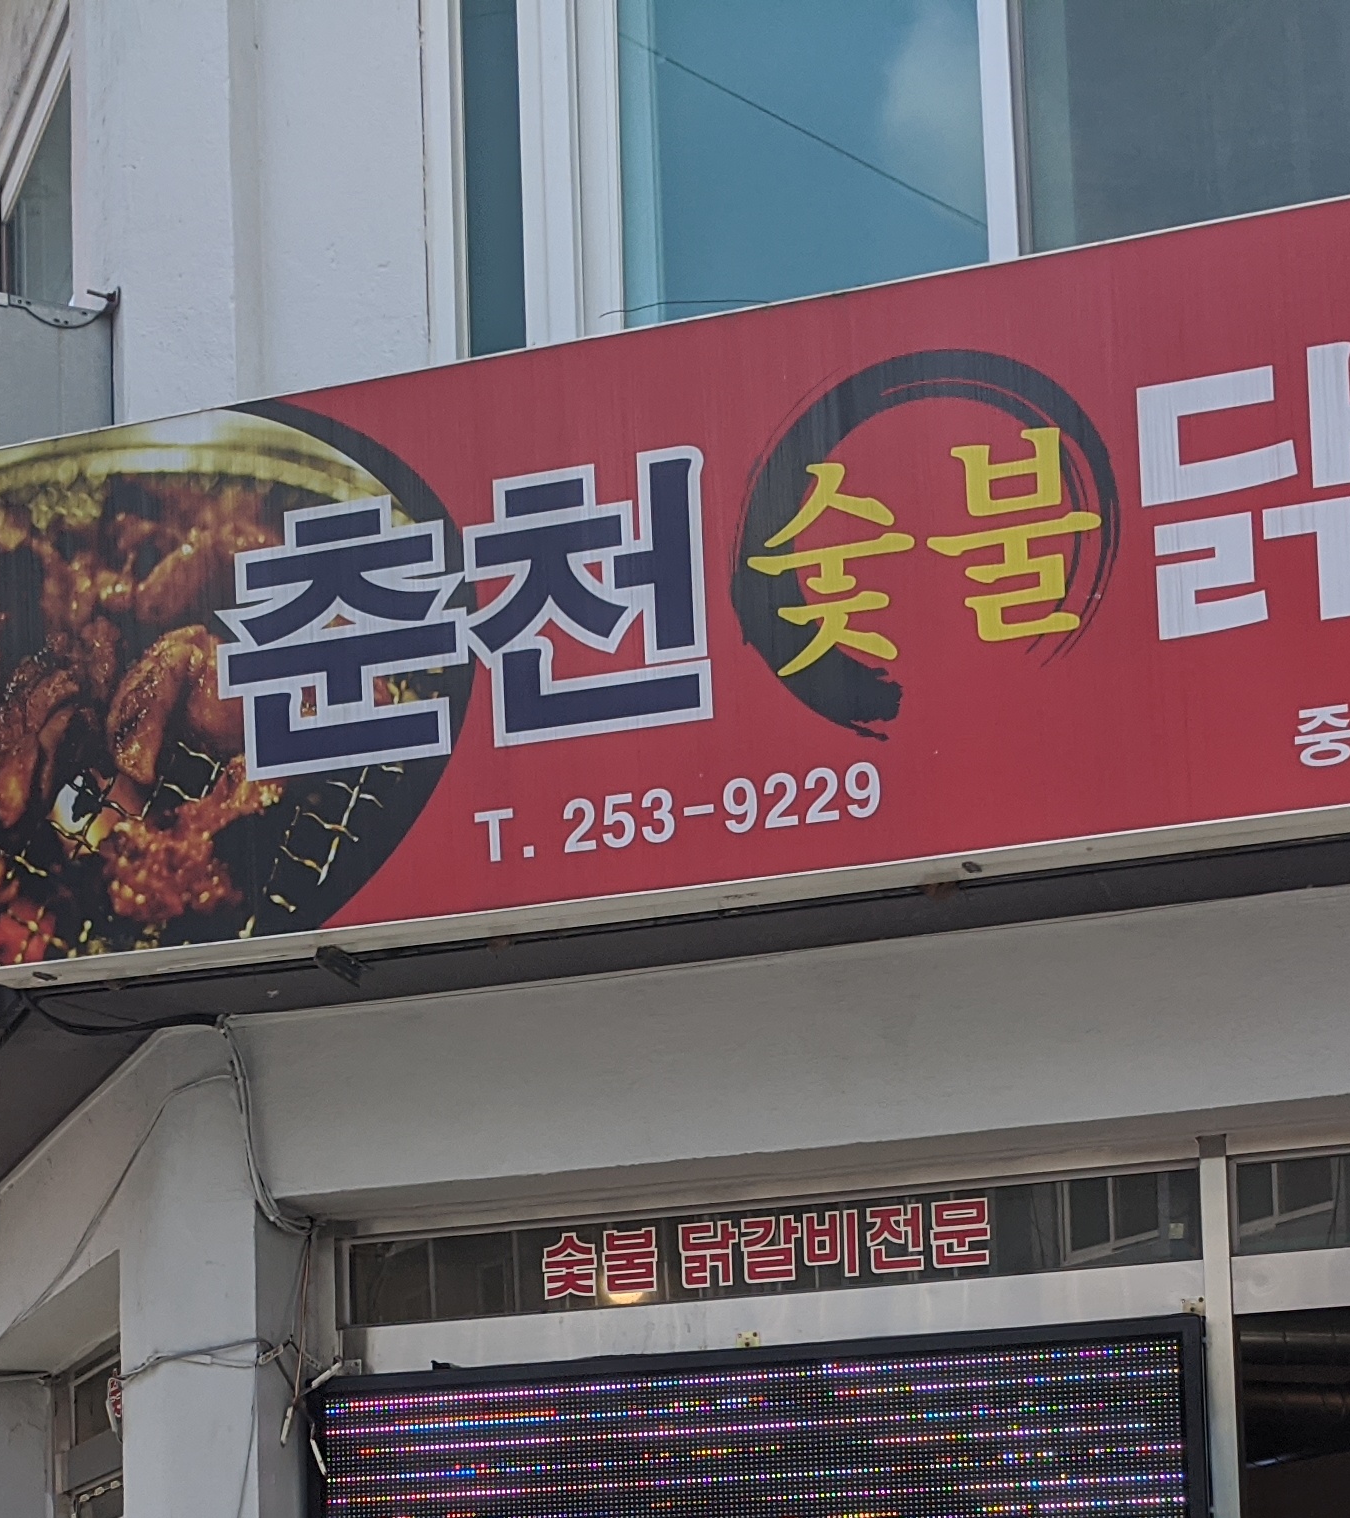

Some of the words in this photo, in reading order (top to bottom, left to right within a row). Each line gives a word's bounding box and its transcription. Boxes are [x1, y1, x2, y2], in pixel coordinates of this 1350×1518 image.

[217, 445, 714, 782] 춘천
[746, 427, 1102, 677] 숯불
[473, 806, 535, 865] T.
[561, 761, 883, 856] 253-9229
[542, 1226, 658, 1302] 숯불
[678, 1197, 992, 1290] 닭갈비전문
